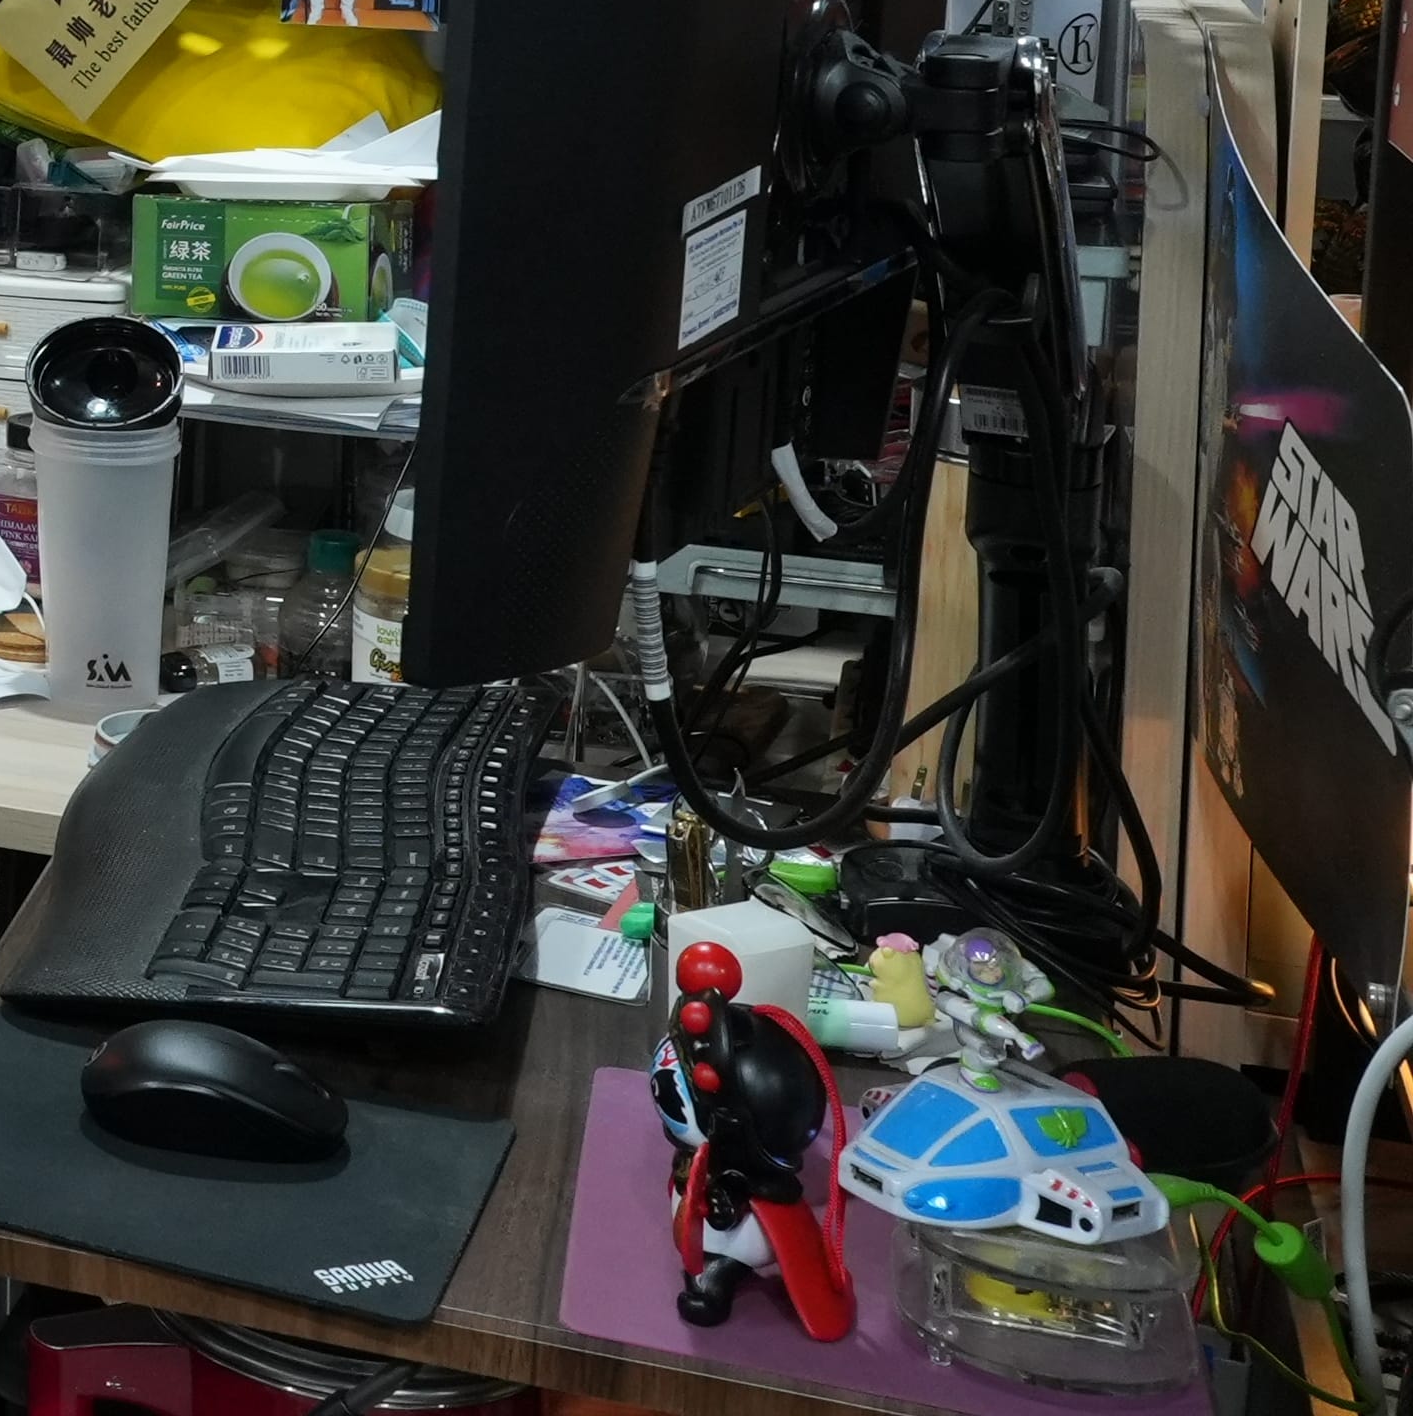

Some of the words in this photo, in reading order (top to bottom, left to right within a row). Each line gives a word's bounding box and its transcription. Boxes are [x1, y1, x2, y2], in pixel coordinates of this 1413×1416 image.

[71, 61, 102, 90] The
[94, 30, 129, 62] best
[161, 219, 206, 232] FairPrice
[169, 240, 212, 262] 绿茶
[162, 271, 187, 280] GREEN
[188, 273, 203, 281] TEA
[1271, 421, 1375, 622] STAR
[0, 529, 22, 541] PINK
[23, 533, 38, 543] SAL
[314, 1260, 408, 1287] SANWA
[331, 1274, 414, 1294] SUPPLY
